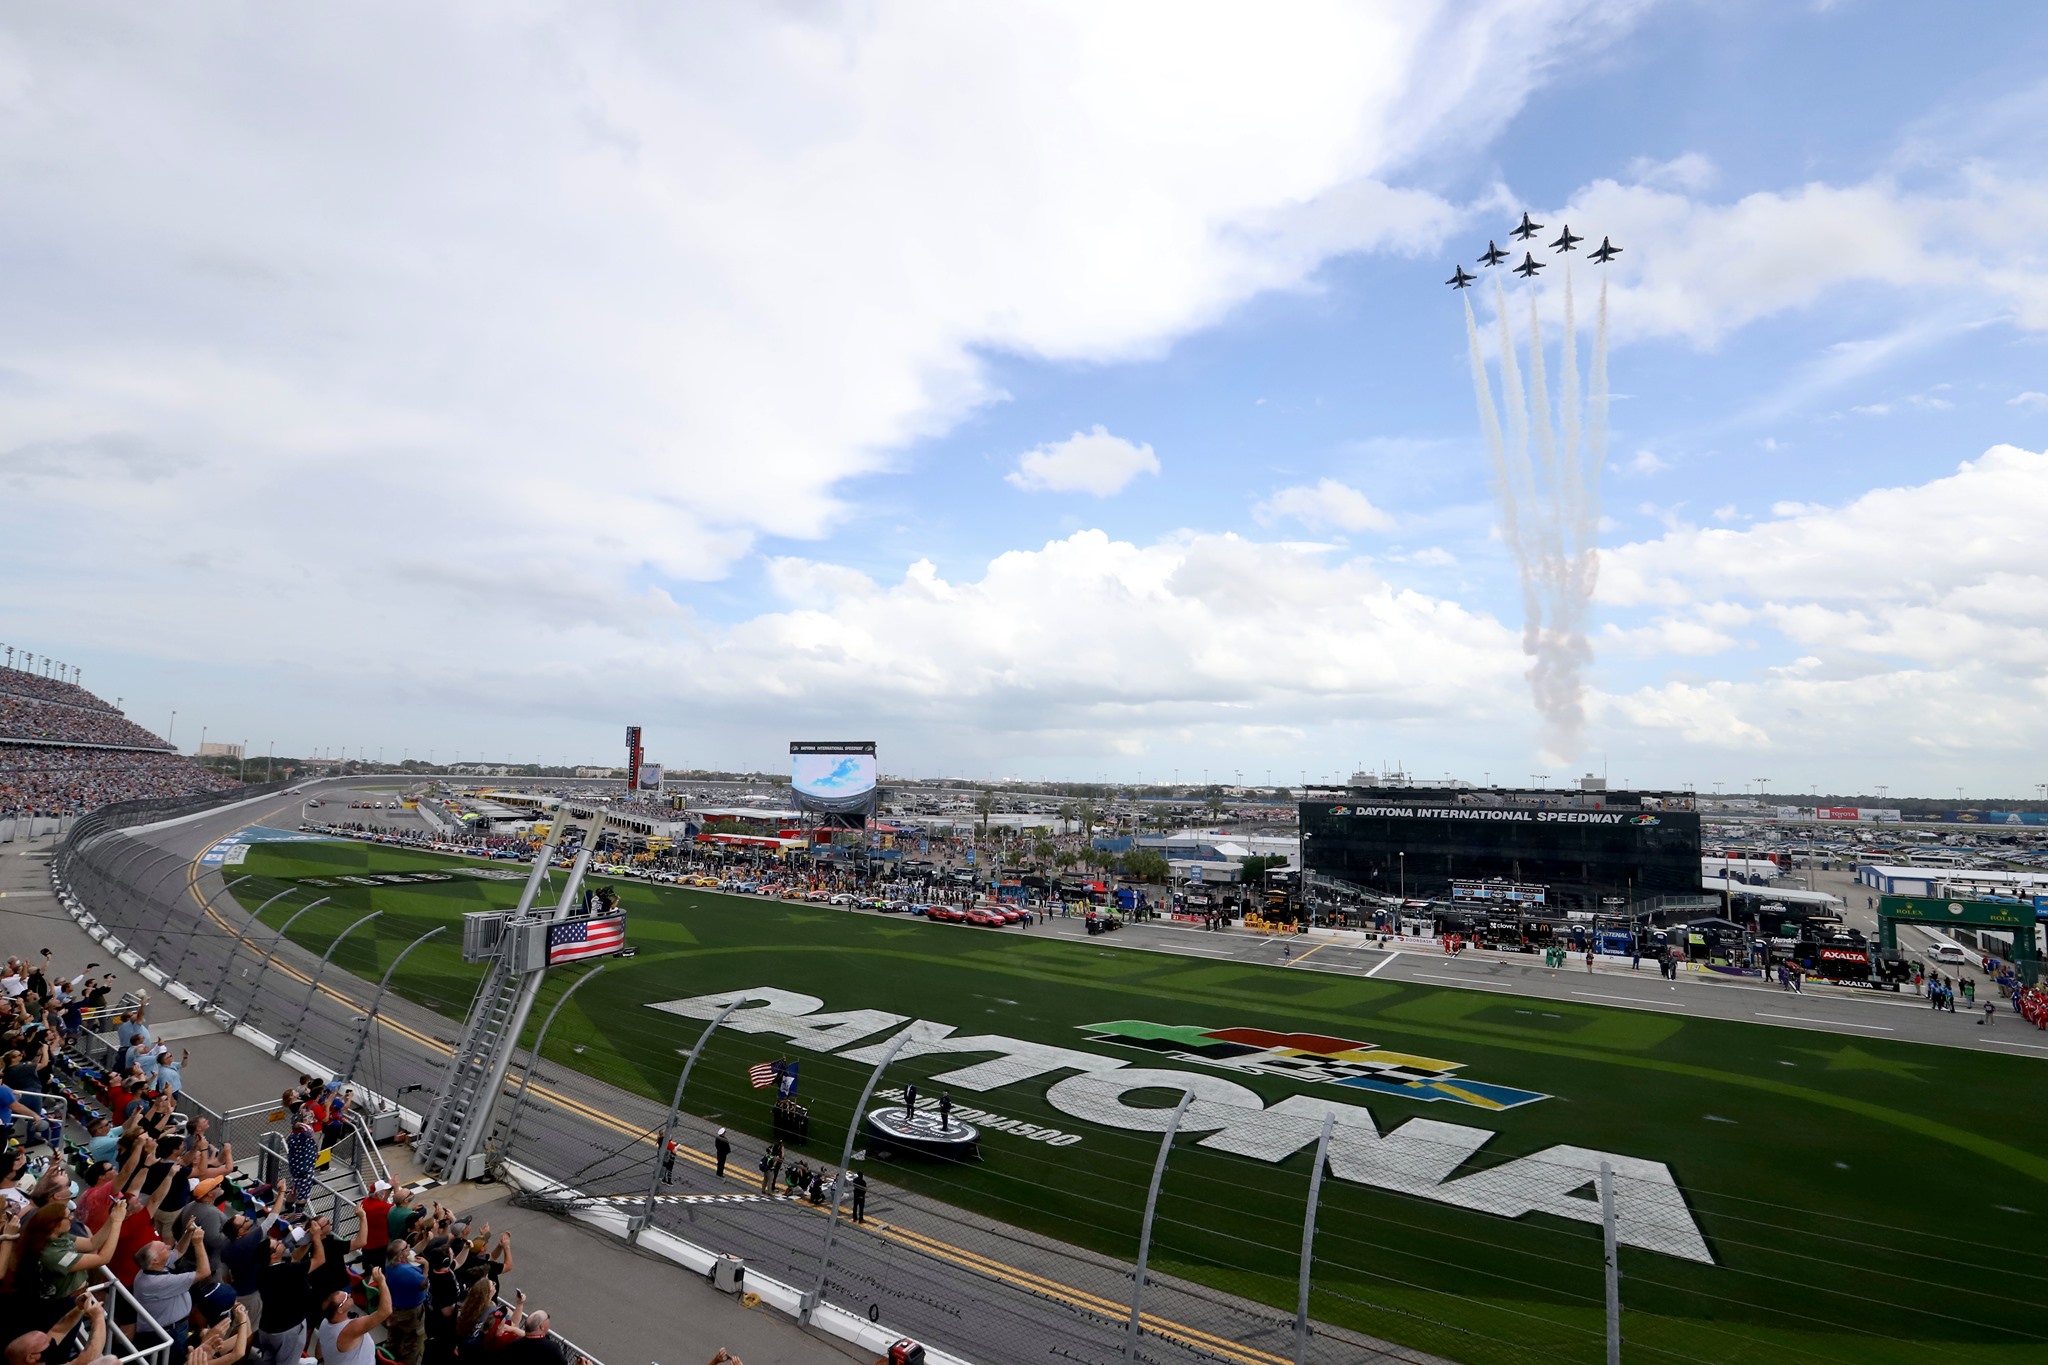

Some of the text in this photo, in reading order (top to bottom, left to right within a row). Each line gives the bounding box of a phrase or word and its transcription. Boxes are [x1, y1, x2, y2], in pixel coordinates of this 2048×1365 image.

[1356, 806, 1623, 824] DAYTONA INTERNATIONAL SPEEDWAY
[1896, 908, 1924, 916] ROLEX
[1823, 951, 1866, 962] AXALTA
[1838, 979, 1874, 989] AXALTA
[643, 986, 1715, 1265] DAYTONA
